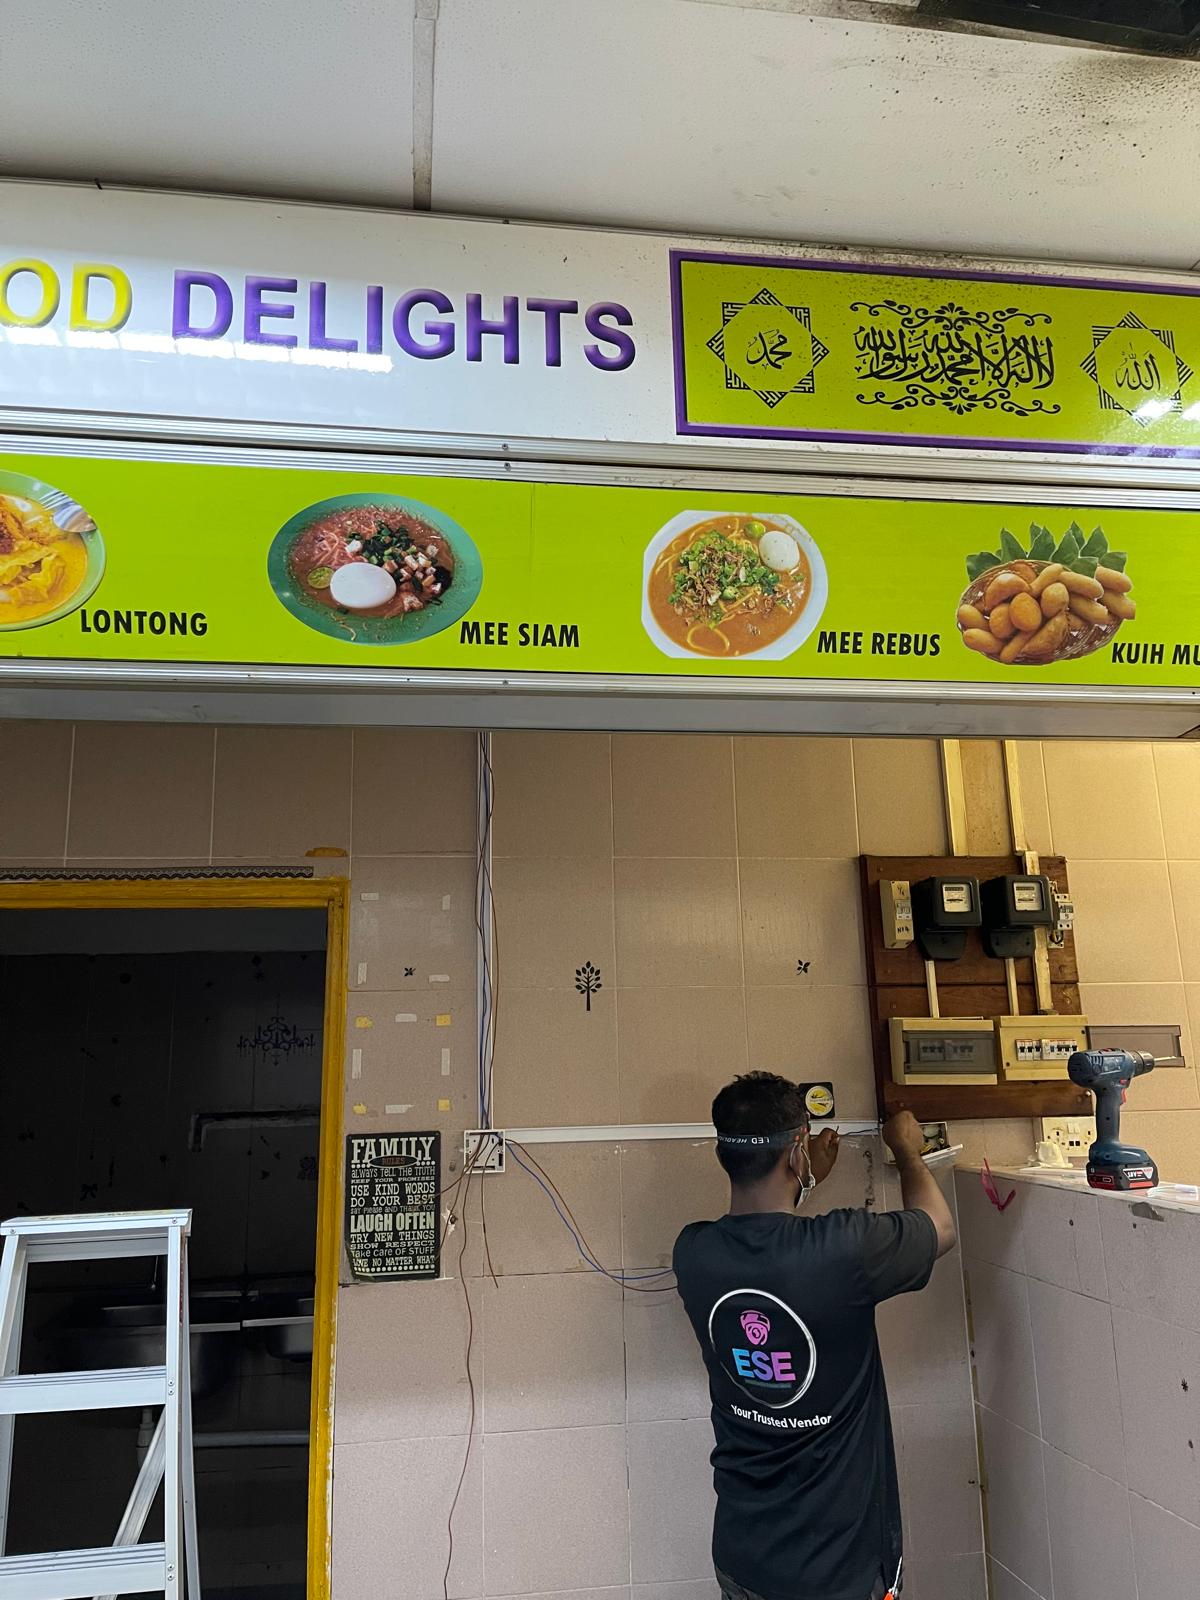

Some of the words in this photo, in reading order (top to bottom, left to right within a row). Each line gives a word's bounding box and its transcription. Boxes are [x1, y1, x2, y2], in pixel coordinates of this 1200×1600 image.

[0, 258, 133, 333] OD
[171, 269, 636, 371] DELIGHTS
[80, 609, 208, 636] LONTONG
[460, 621, 509, 646] MEE
[518, 623, 580, 648] SIAM
[817, 630, 864, 654] MEE
[871, 632, 941, 656] REBUS
[1112, 642, 1165, 665] KUIH
[351, 1136, 435, 1163] FAMILY
[751, 1136, 770, 1145] LED
[350, 1184, 369, 1197] USE
[375, 1183, 400, 1196] KIND
[405, 1182, 435, 1194] WORDS
[350, 1197, 365, 1207] DO
[372, 1196, 400, 1206] YOUR
[407, 1194, 435, 1205] BEST
[350, 1213, 393, 1233] LAUGH
[395, 1211, 435, 1231] OFTEN
[350, 1233, 369, 1243] TRY
[374, 1232, 393, 1242] NEW
[399, 1230, 435, 1241] THINGS
[350, 1242, 379, 1250] SHOW
[385, 1240, 435, 1248] RESPECT
[372, 1258, 382, 1266] NO
[385, 1256, 413, 1266] MATTER
[416, 1255, 435, 1264] WHAT
[408, 1246, 435, 1255] STUFF
[731, 1347, 796, 1382] ESE
[730, 1404, 752, 1420] Your
[751, 1409, 788, 1428] Trusted
[788, 1415, 832, 1428] Vendor
